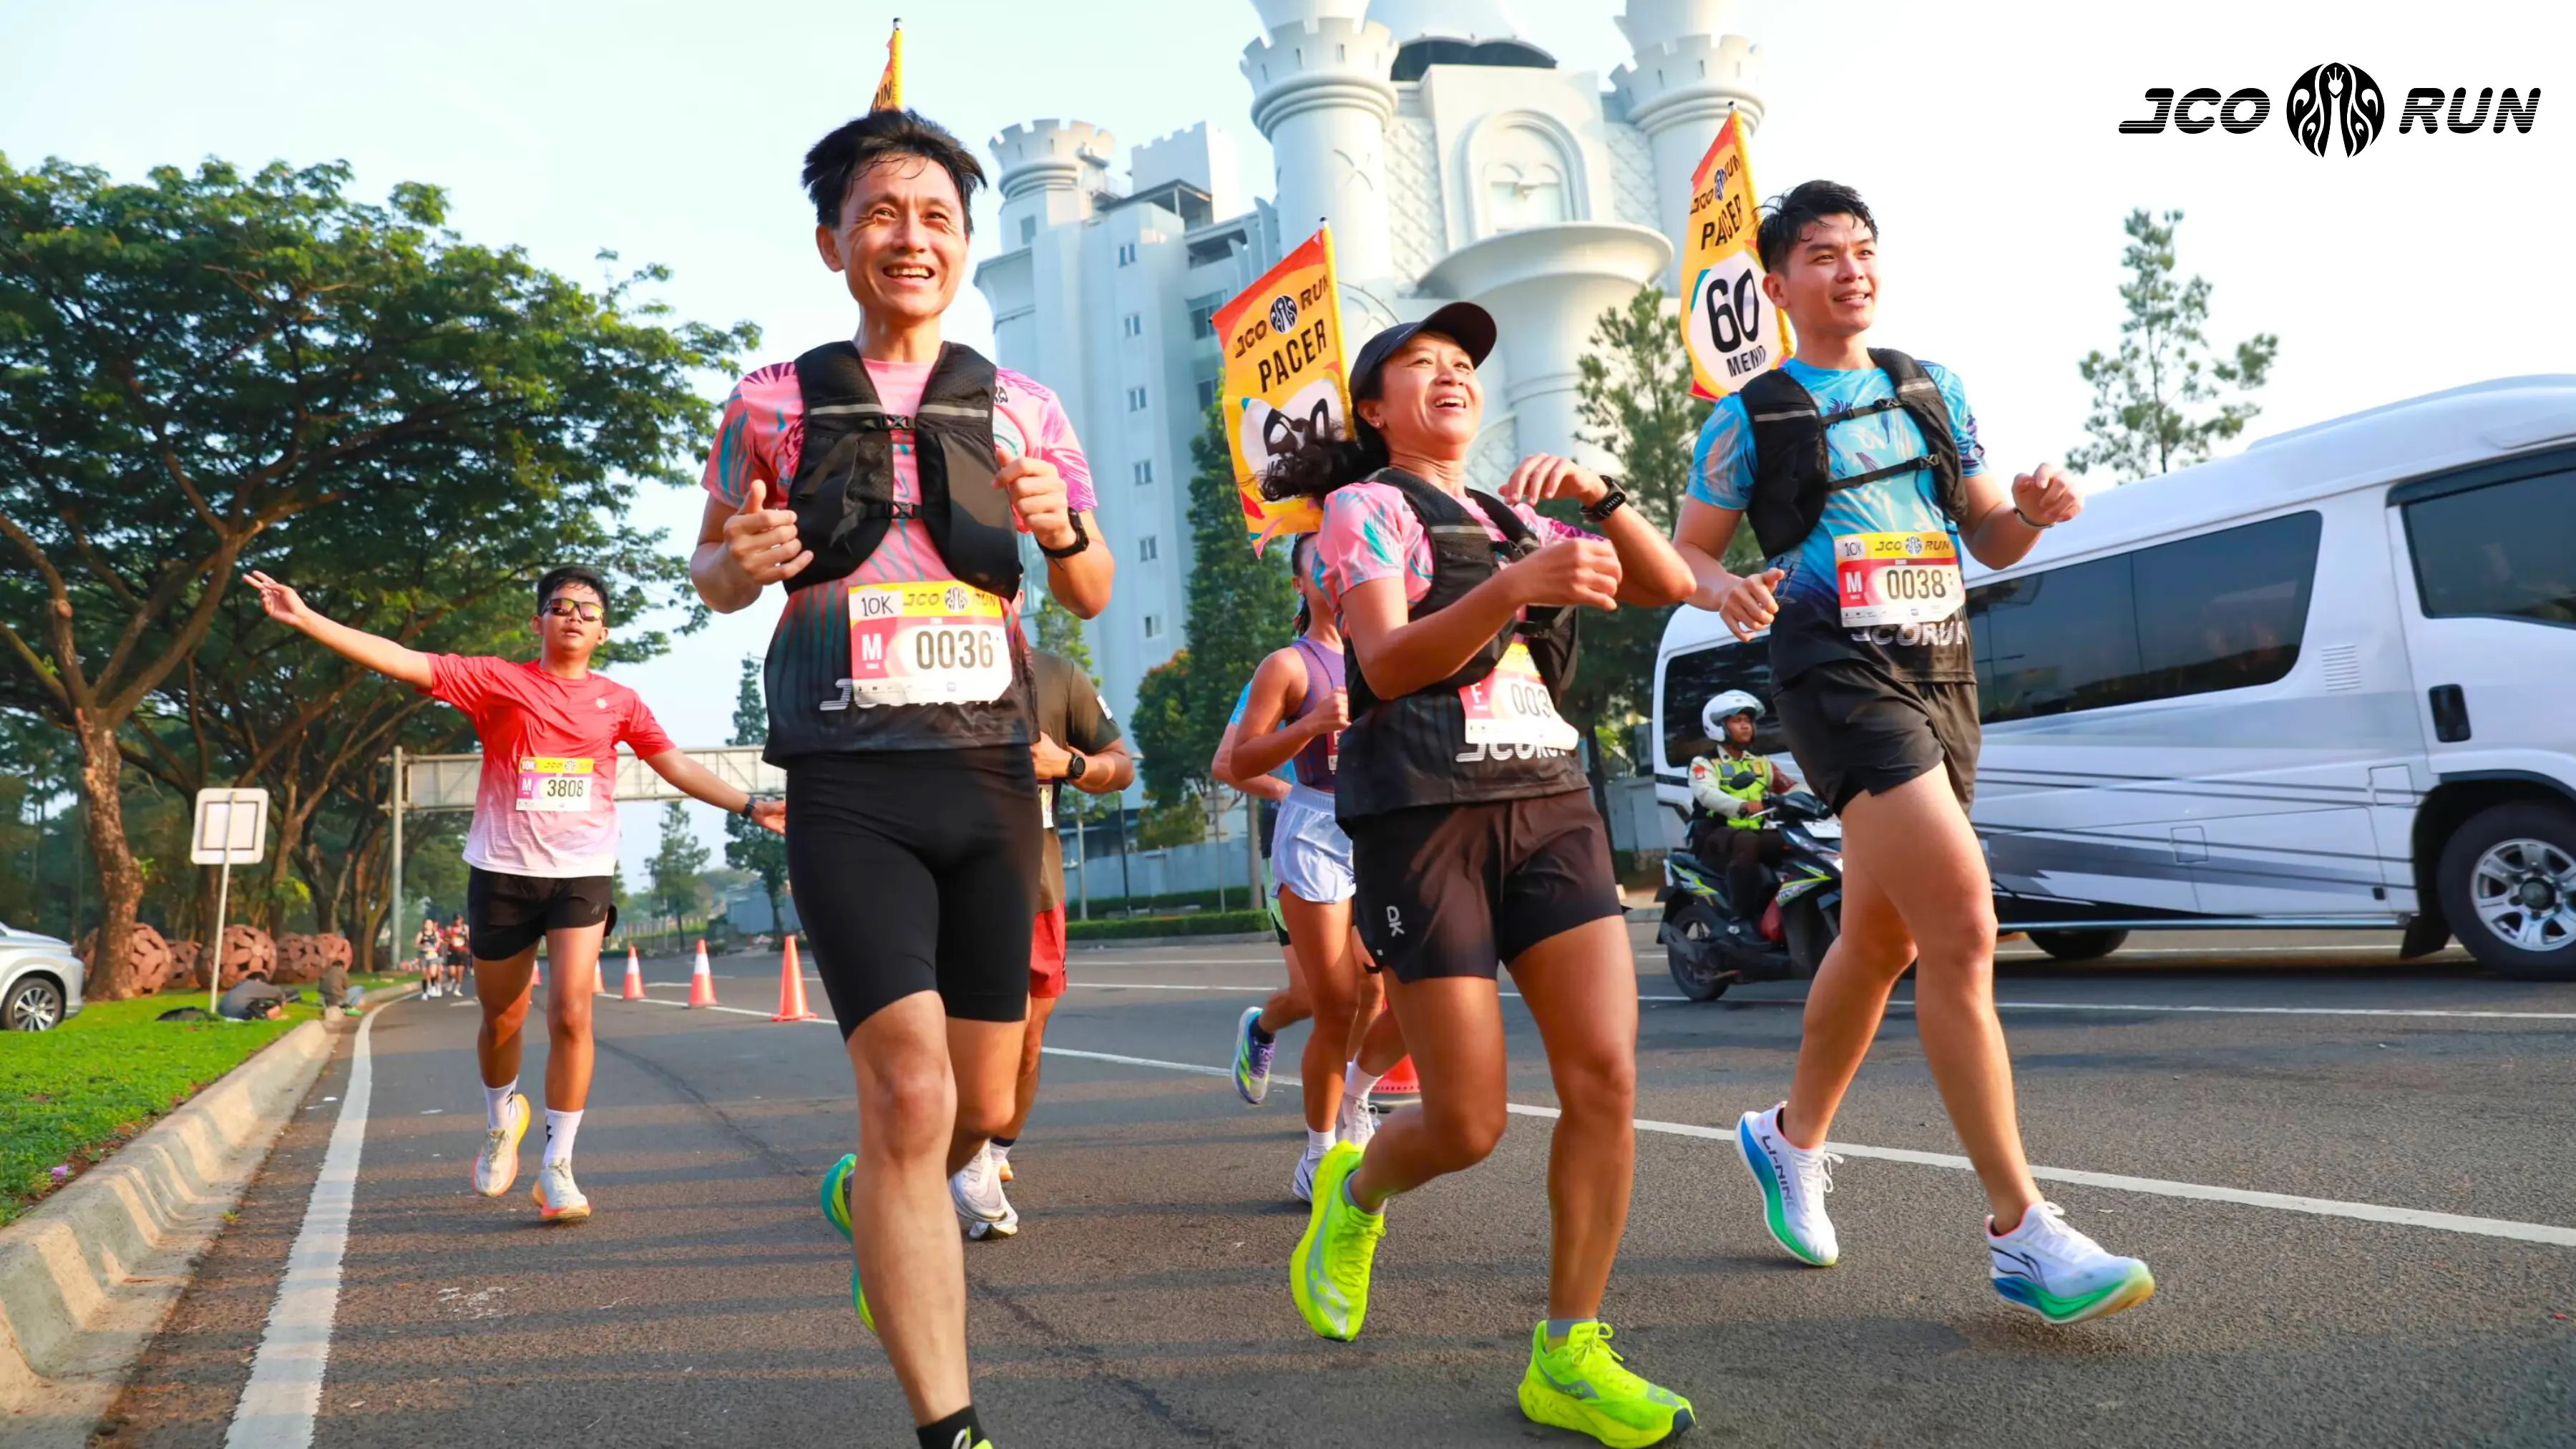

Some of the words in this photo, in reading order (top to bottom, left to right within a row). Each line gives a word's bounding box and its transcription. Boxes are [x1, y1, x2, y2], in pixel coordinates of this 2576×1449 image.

[872, 79, 892, 109] UN
[1701, 194, 1743, 250] PACER
[1707, 268, 1760, 353] 60
[1235, 319, 1267, 358] JCO
[1259, 318, 1326, 393] PACER
[1844, 542, 1863, 557] 10K
[1875, 540, 1902, 551] JCO
[1925, 540, 1950, 550] RUN
[1845, 571, 1863, 592] M
[1886, 569, 1946, 600] 0038
[861, 595, 894, 617] 10K
[903, 593, 940, 605] JCO
[862, 633, 882, 660] M
[916, 630, 993, 669] 0036
[1470, 683, 1483, 703] F
[522, 778, 532, 791] M
[547, 779, 583, 796] 3808
